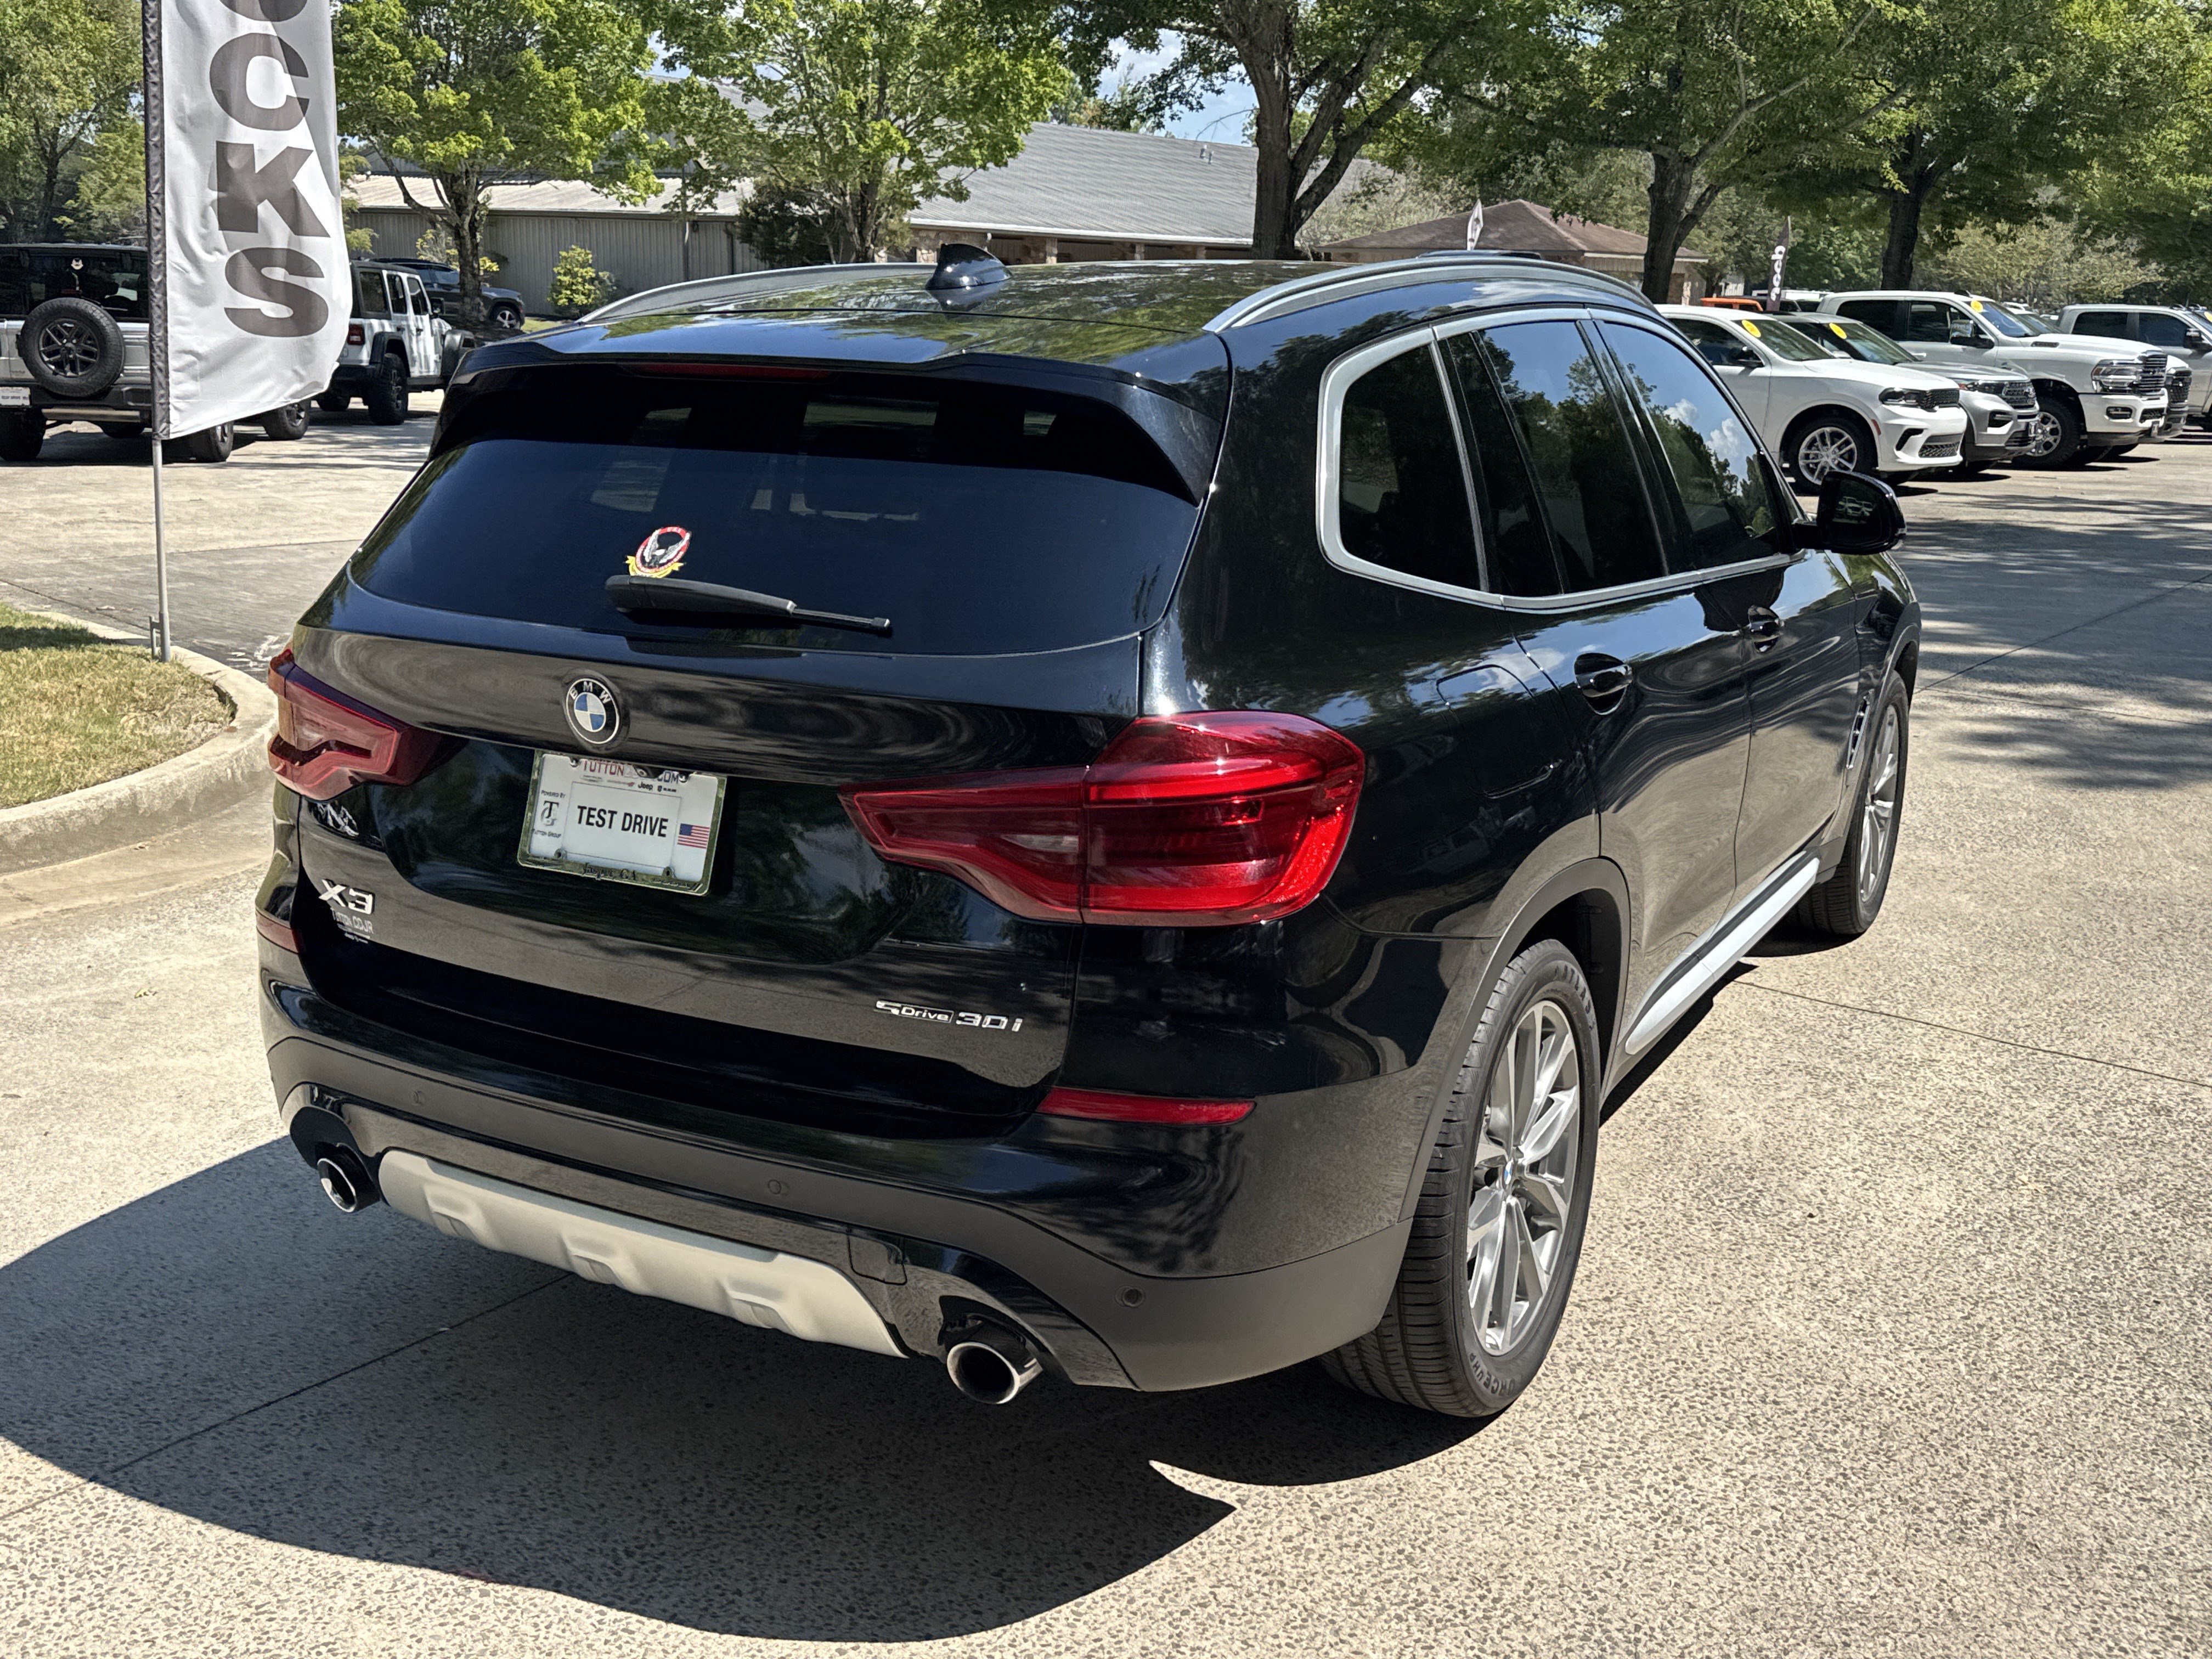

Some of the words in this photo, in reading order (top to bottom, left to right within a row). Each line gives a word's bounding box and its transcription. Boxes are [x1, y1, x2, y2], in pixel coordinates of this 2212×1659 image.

[569, 681, 612, 704] BMW
[577, 805, 618, 830] TEST
[621, 812, 669, 838] DRIVE
[318, 879, 373, 915] X3
[956, 1012, 1023, 1032] 30i
